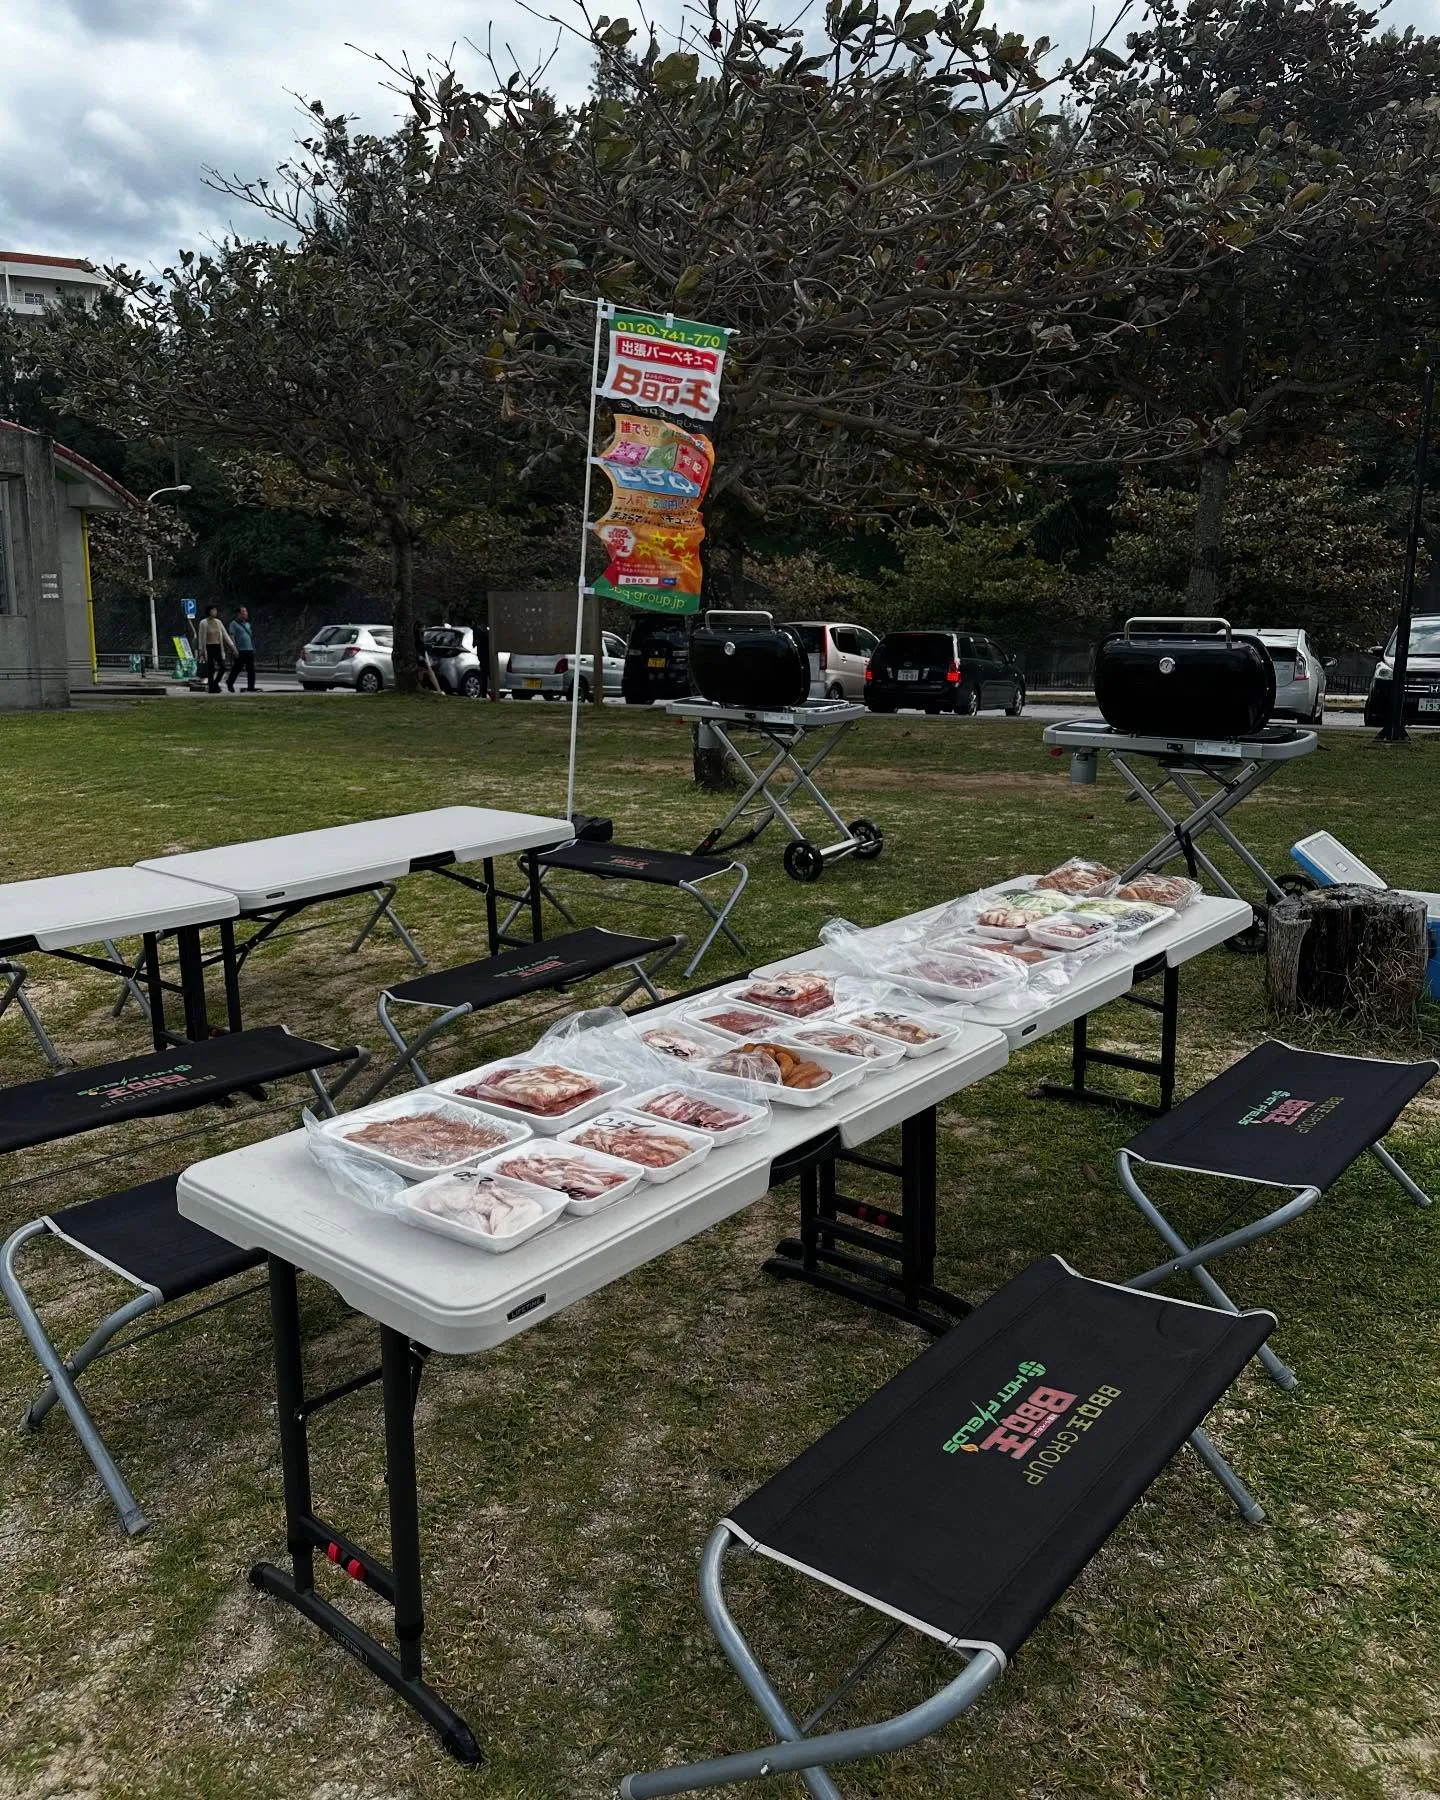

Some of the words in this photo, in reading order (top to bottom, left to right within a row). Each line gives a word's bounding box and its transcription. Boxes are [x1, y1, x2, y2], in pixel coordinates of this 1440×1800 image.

[617, 321, 720, 347] 0120-741-770
[621, 340, 714, 365] 出張バーベキュー
[611, 363, 712, 414] BBQ王
[593, 1117, 656, 1134] 250
[996, 1374, 1028, 1403] HOT
[979, 1385, 1078, 1460] BBQ王
[1065, 1384, 1122, 1432] BBQ王
[1022, 1431, 1079, 1485] GROUP
